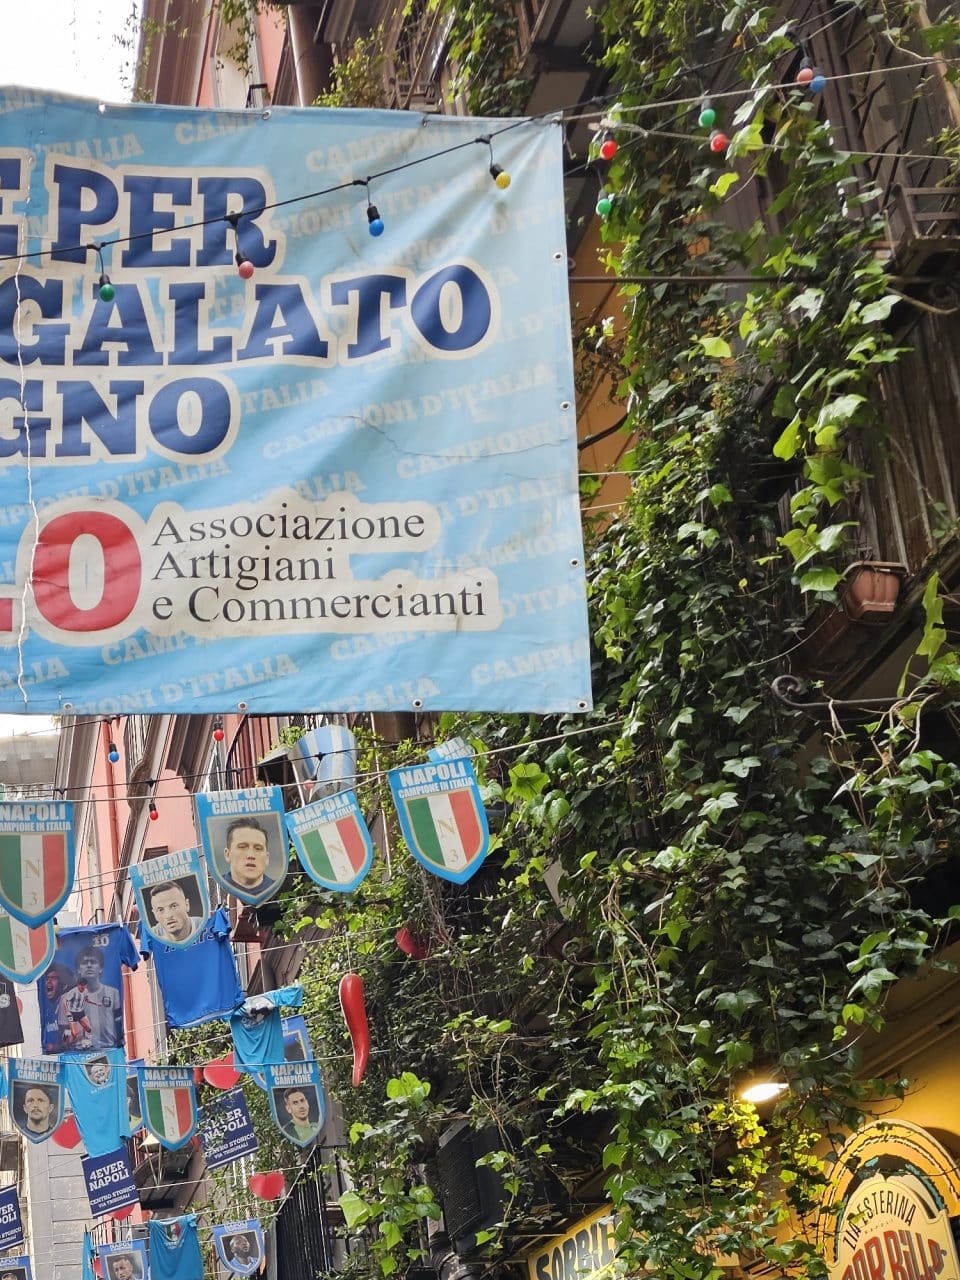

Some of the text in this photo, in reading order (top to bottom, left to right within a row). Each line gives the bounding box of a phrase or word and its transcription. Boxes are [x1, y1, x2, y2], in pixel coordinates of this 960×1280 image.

[50, 163, 277, 269] PER
[152, 502, 426, 546] Associazione
[152, 549, 337, 590] Artigiani
[152, 580, 486, 623] e Commercianti
[399, 762, 467, 788] NAPOLI
[206, 785, 275, 804] NAPOLI
[398, 782, 440, 798] CAMPIONE
[448, 776, 474, 789] ITALIA
[211, 798, 272, 815] CAMPIONE
[292, 793, 351, 824] NAPOLI
[45, 820, 71, 832] ITALIA
[138, 850, 192, 876] NAPOLI
[143, 864, 192, 887] CAMPIONE
[16, 1059, 61, 1074] NAPOLI
[17, 1069, 58, 1083] CAMPIONE
[144, 1067, 189, 1082] NAPOLI
[270, 1061, 314, 1077] NAPOLI
[274, 1073, 312, 1085] CAMPIONE
[89, 1160, 125, 1181] 4EVER
[89, 1170, 130, 1192] NAPOLI
[91, 1184, 136, 1205] CENTRO STORICO
